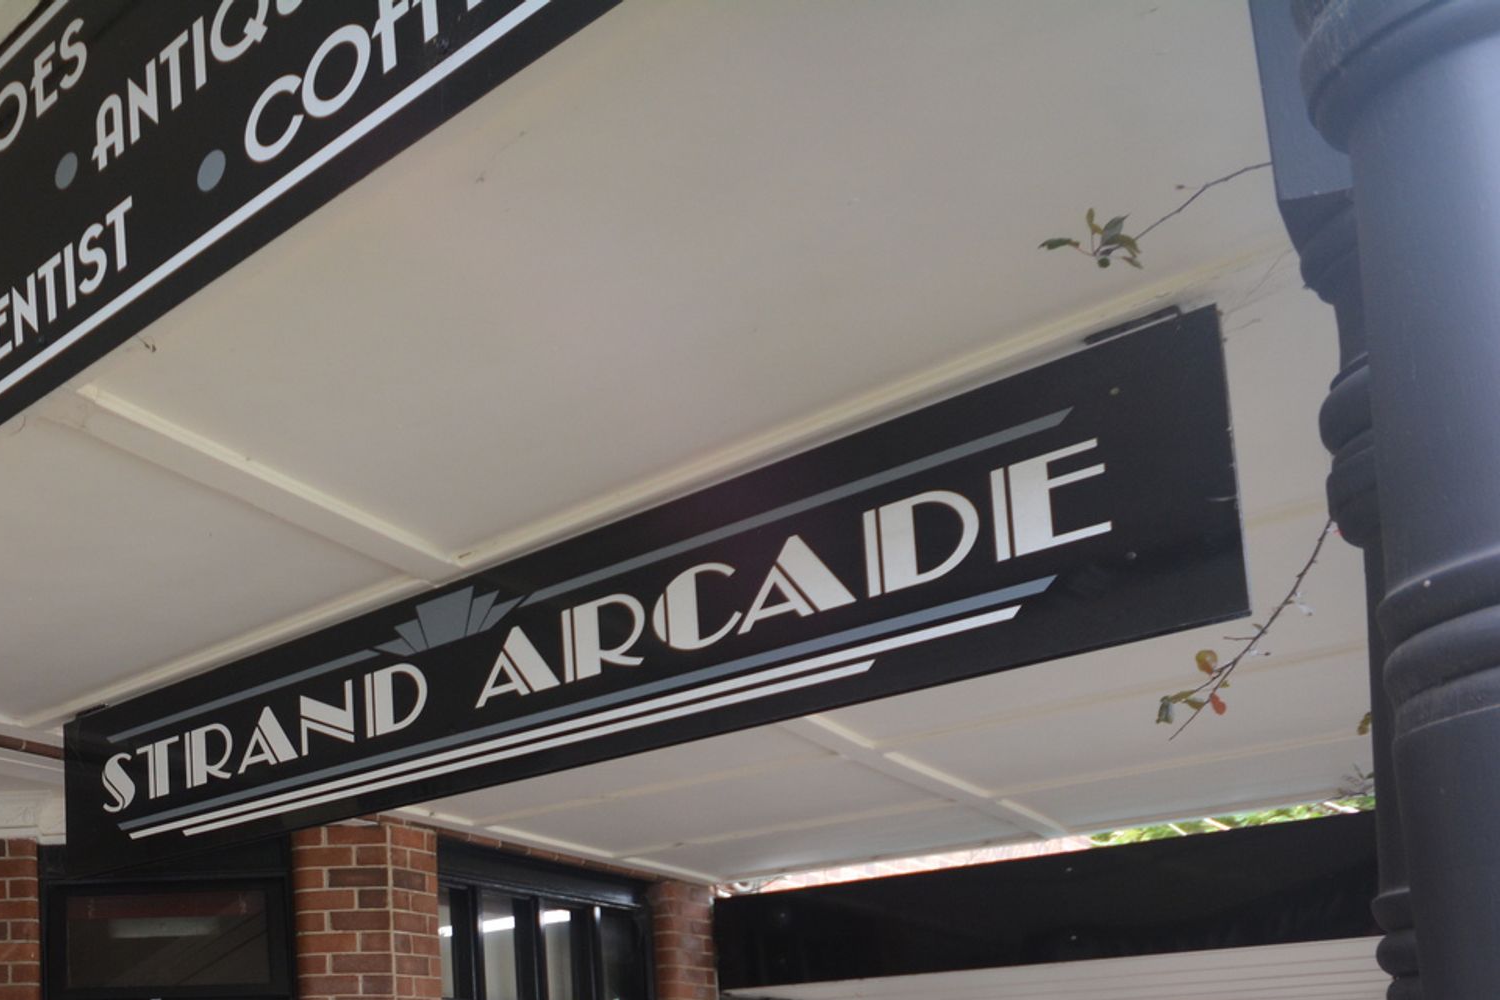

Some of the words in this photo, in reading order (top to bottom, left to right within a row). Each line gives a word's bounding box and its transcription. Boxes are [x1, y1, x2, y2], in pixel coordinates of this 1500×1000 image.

[92, 0, 302, 172] ANTIQ
[244, 0, 484, 162] COF
[99, 661, 430, 816] STRAND
[475, 436, 1114, 711] ARCADE
